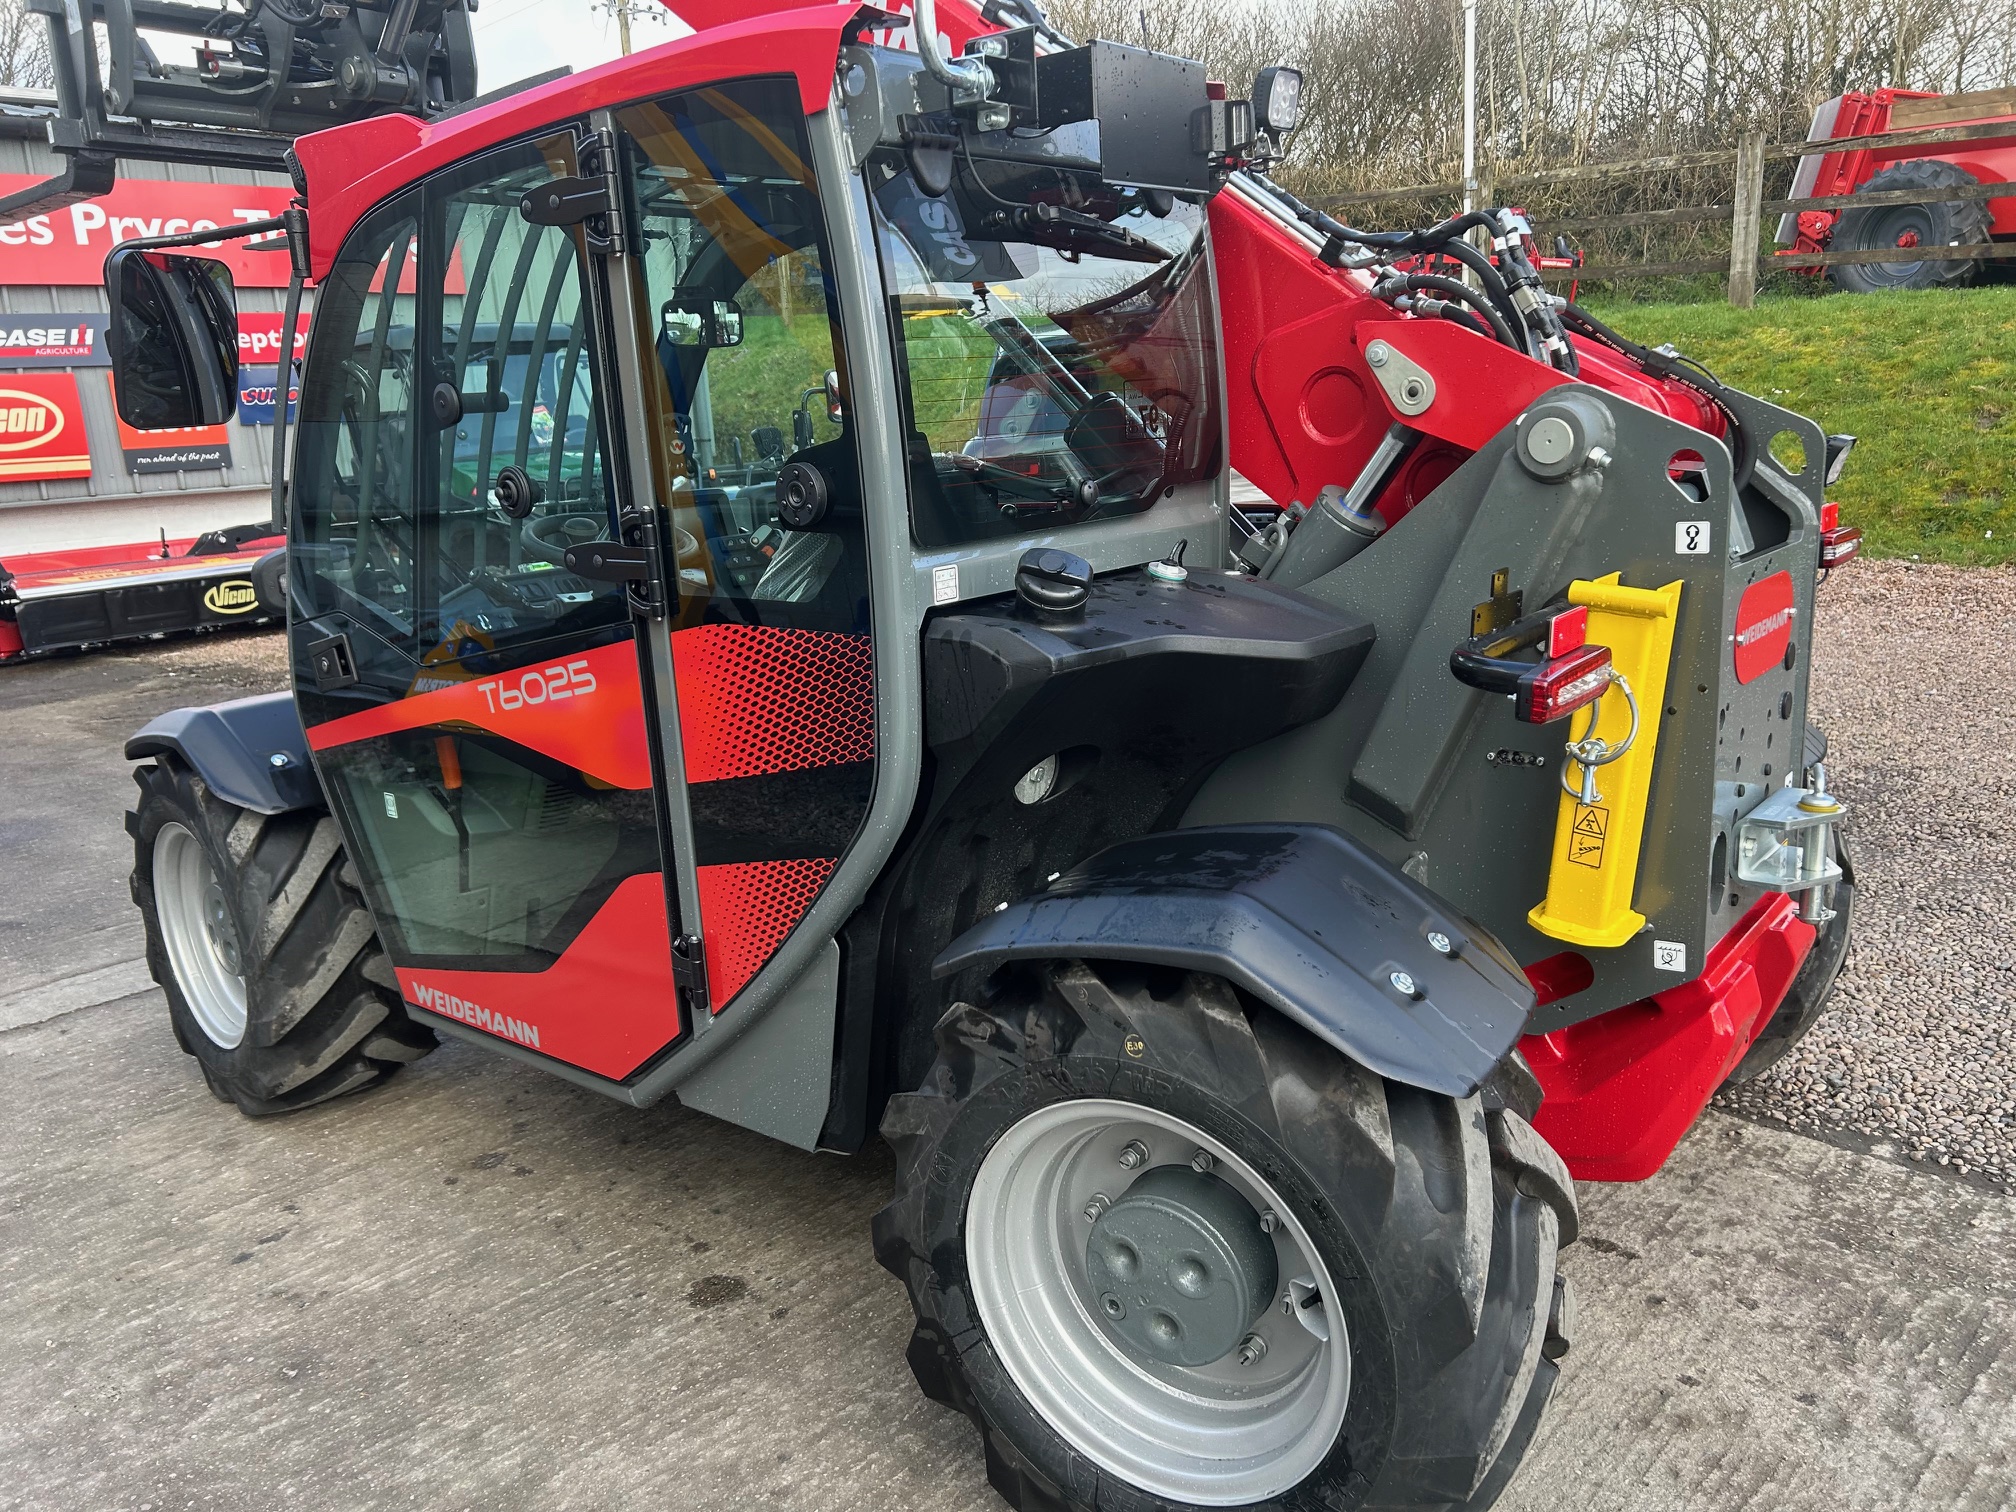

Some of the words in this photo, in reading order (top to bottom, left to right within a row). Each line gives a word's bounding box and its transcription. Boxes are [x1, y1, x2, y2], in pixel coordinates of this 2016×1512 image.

[35, 347, 89, 355] AGRICULTURE
[152, 453, 177, 463] ahead
[188, 452, 200, 461] the
[200, 451, 219, 462] pack
[209, 583, 256, 610] Vicon
[478, 660, 597, 713] T6025
[412, 981, 540, 1048] WEIDEMANN
